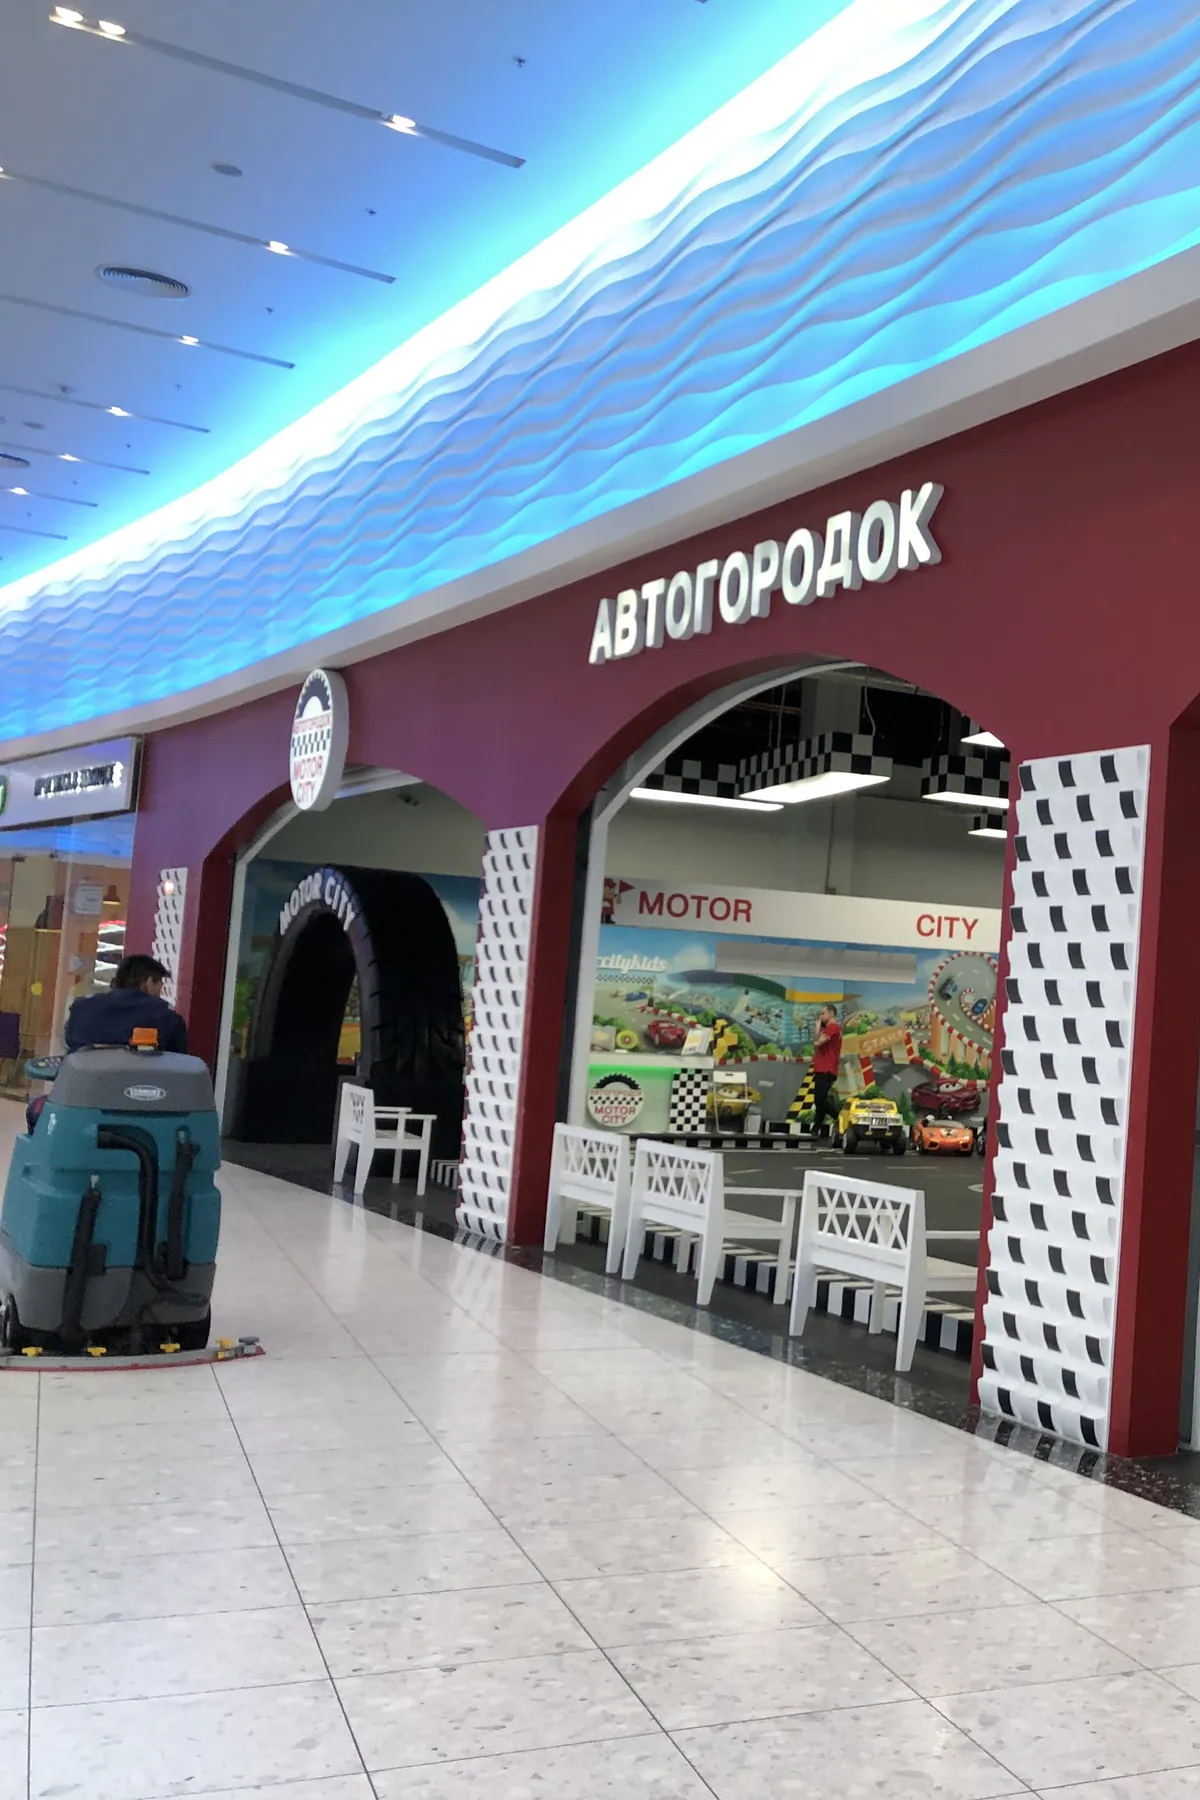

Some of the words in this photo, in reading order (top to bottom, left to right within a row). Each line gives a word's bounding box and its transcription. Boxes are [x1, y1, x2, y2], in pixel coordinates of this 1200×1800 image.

[588, 481, 944, 665] АВТОГОРОДОК
[293, 755, 324, 778] MOTOR
[296, 781, 315, 804] CITY
[280, 872, 322, 936] MOTOR
[325, 876, 355, 931] CITY
[638, 891, 752, 923] MOTOR
[916, 914, 978, 940] CITY
[594, 1105, 636, 1115] MOTOR
[601, 1115, 628, 1124] CITY
